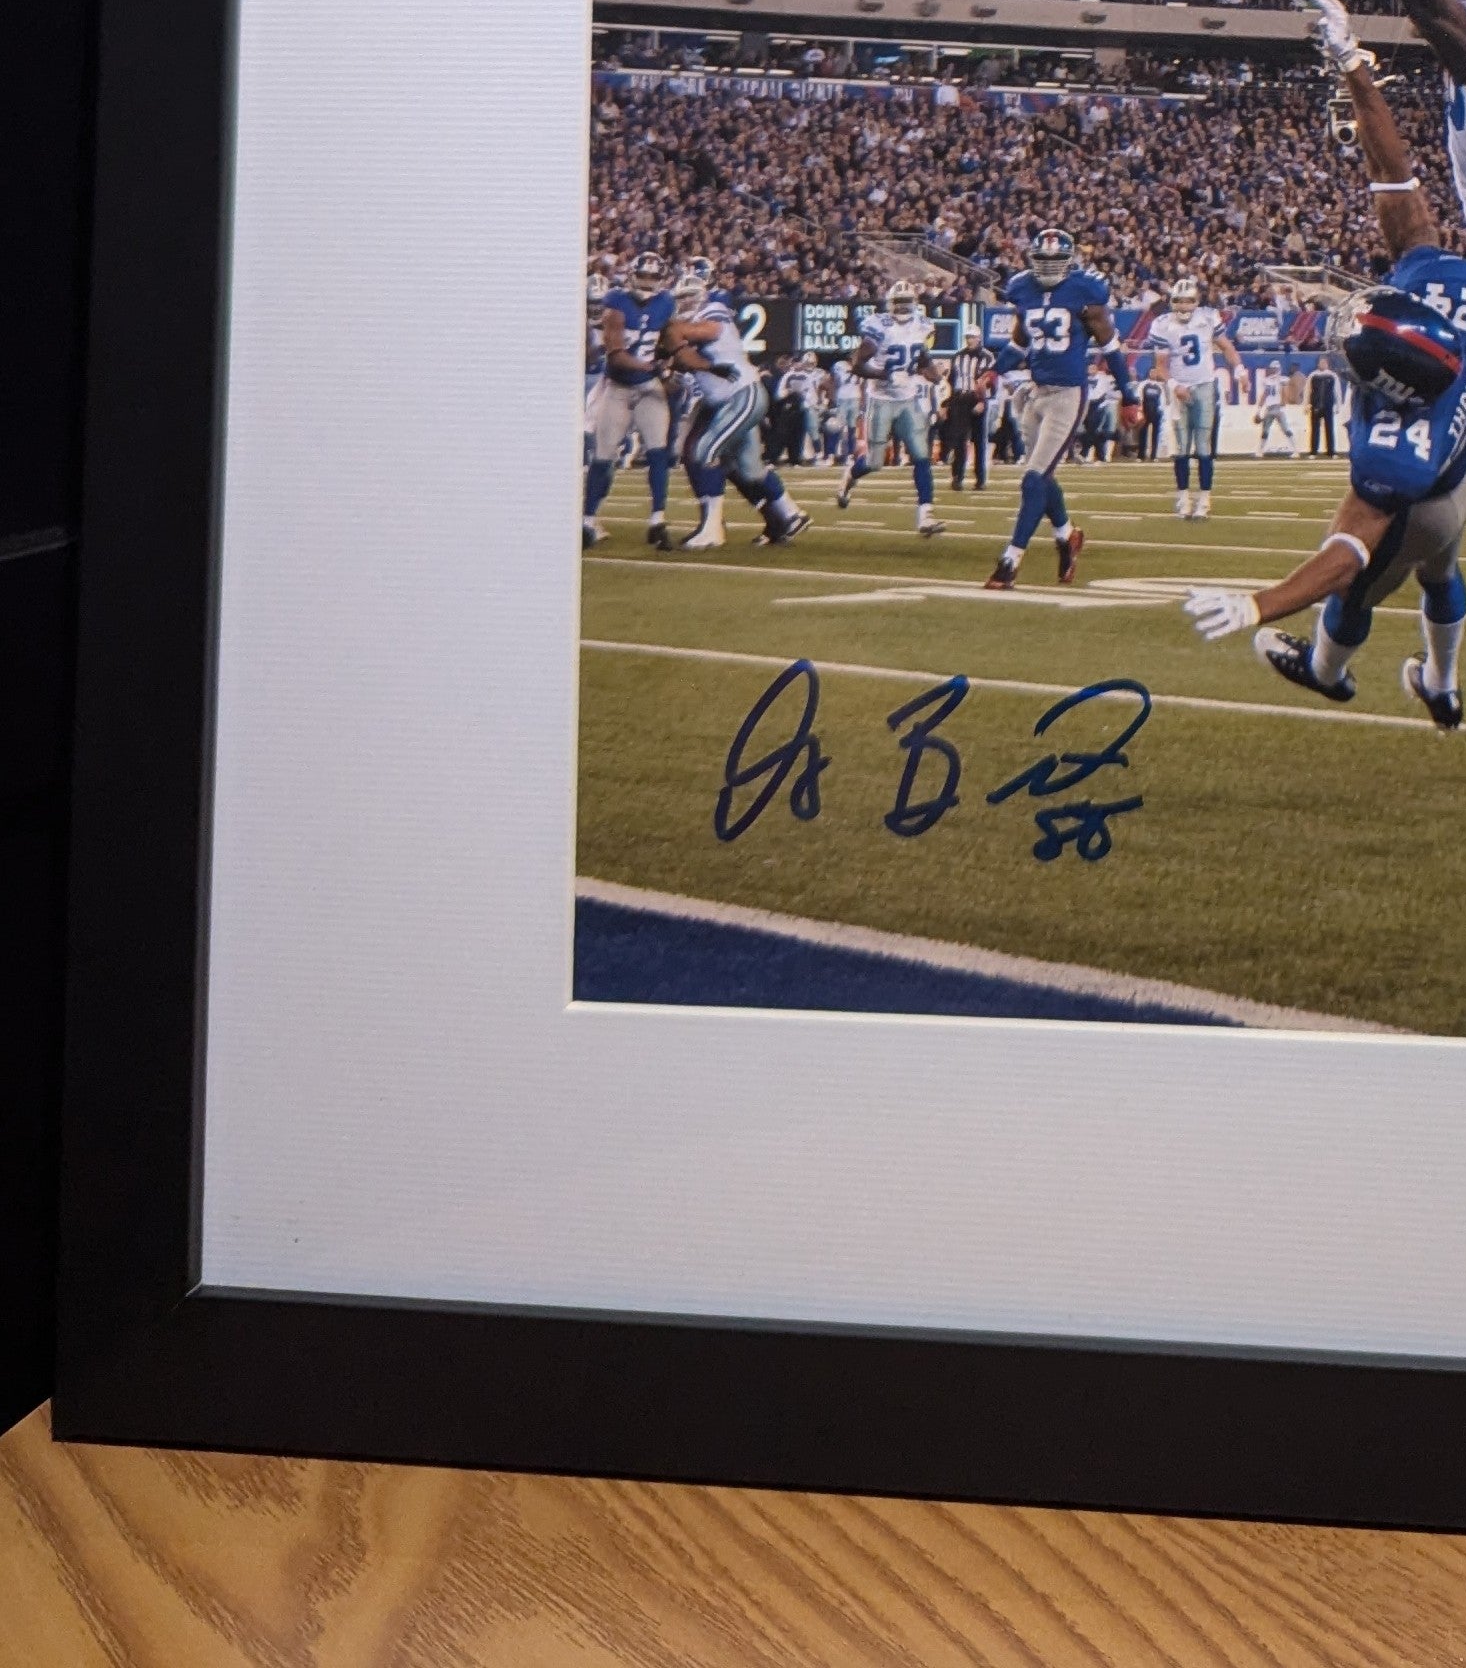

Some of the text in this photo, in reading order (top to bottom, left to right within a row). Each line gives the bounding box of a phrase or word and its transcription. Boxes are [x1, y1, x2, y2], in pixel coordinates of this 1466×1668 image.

[739, 303, 767, 352] 2
[805, 303, 848, 320] DOWN
[805, 320, 846, 335] TO GO
[804, 335, 862, 350] BALL ON
[1025, 307, 1071, 352] 53
[1180, 333, 1201, 366] 3
[1367, 410, 1432, 462] 24
